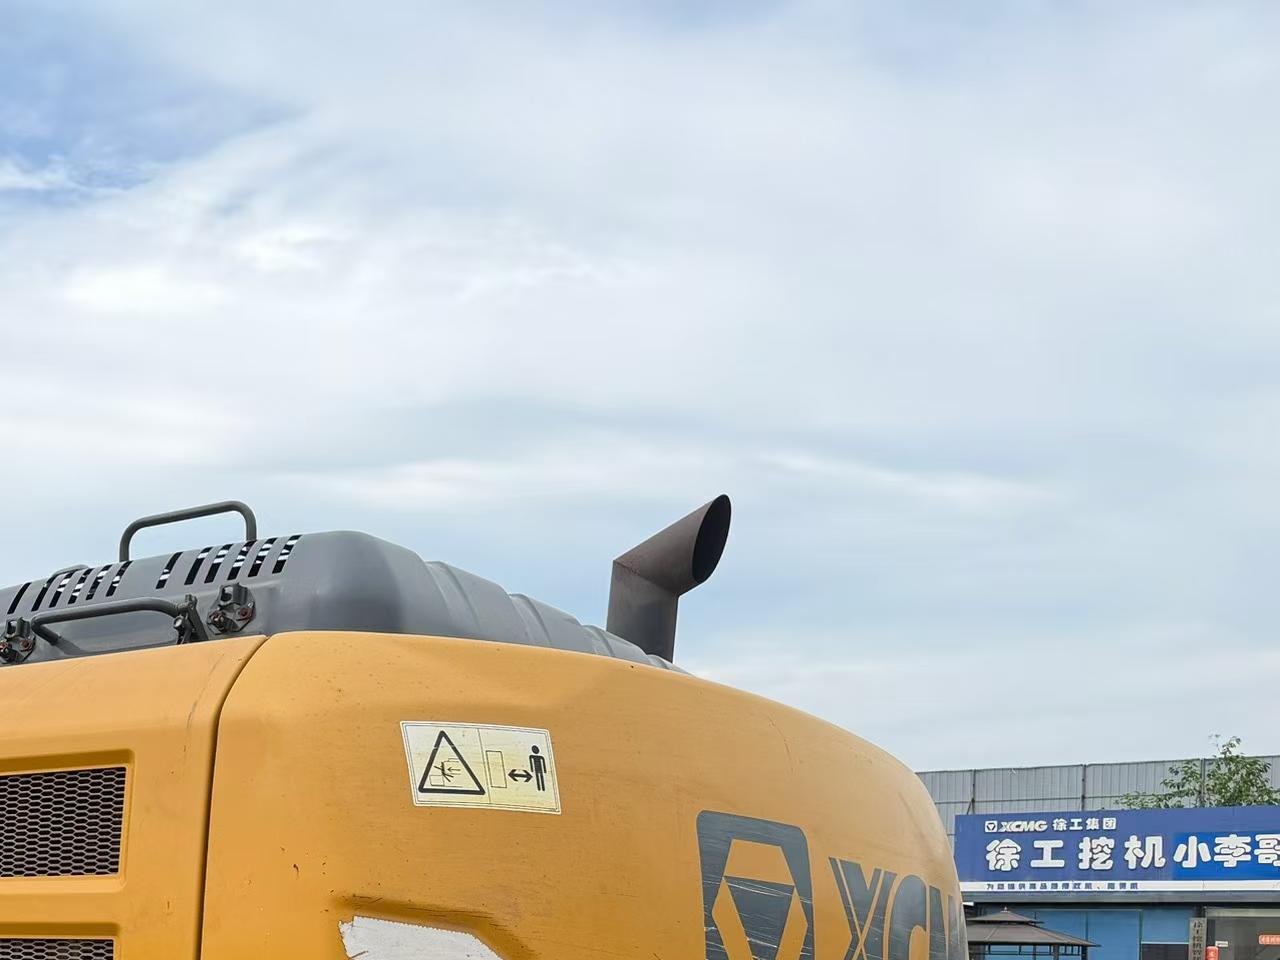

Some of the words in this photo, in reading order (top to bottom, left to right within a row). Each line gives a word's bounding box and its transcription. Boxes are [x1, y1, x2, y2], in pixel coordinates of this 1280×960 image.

[998, 820, 1048, 832] XCMG
[1052, 817, 1117, 831] 徐工集团
